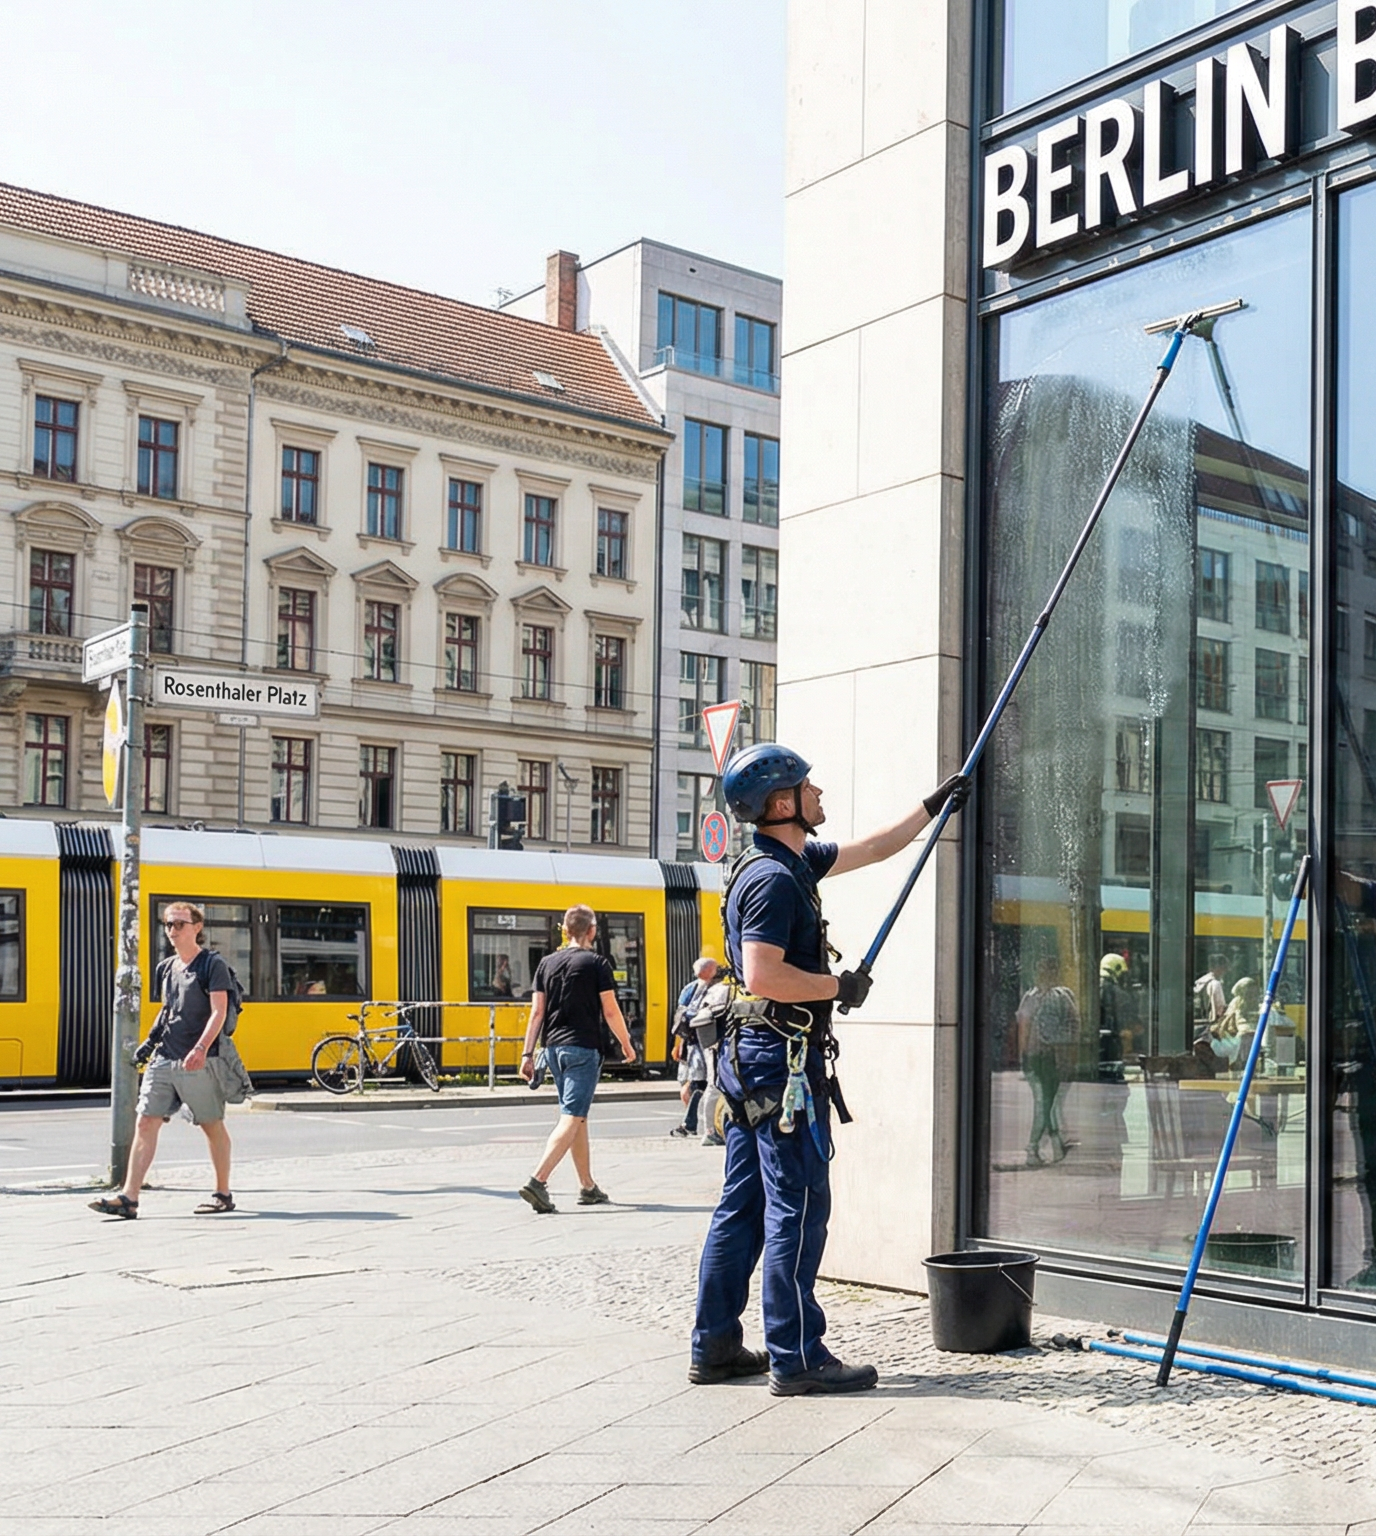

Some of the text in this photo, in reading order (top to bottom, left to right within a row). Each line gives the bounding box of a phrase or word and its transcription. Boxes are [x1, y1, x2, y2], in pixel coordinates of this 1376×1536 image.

[983, 23, 1289, 268] BERLIN
[164, 676, 308, 707] Rosenthaler Platz
